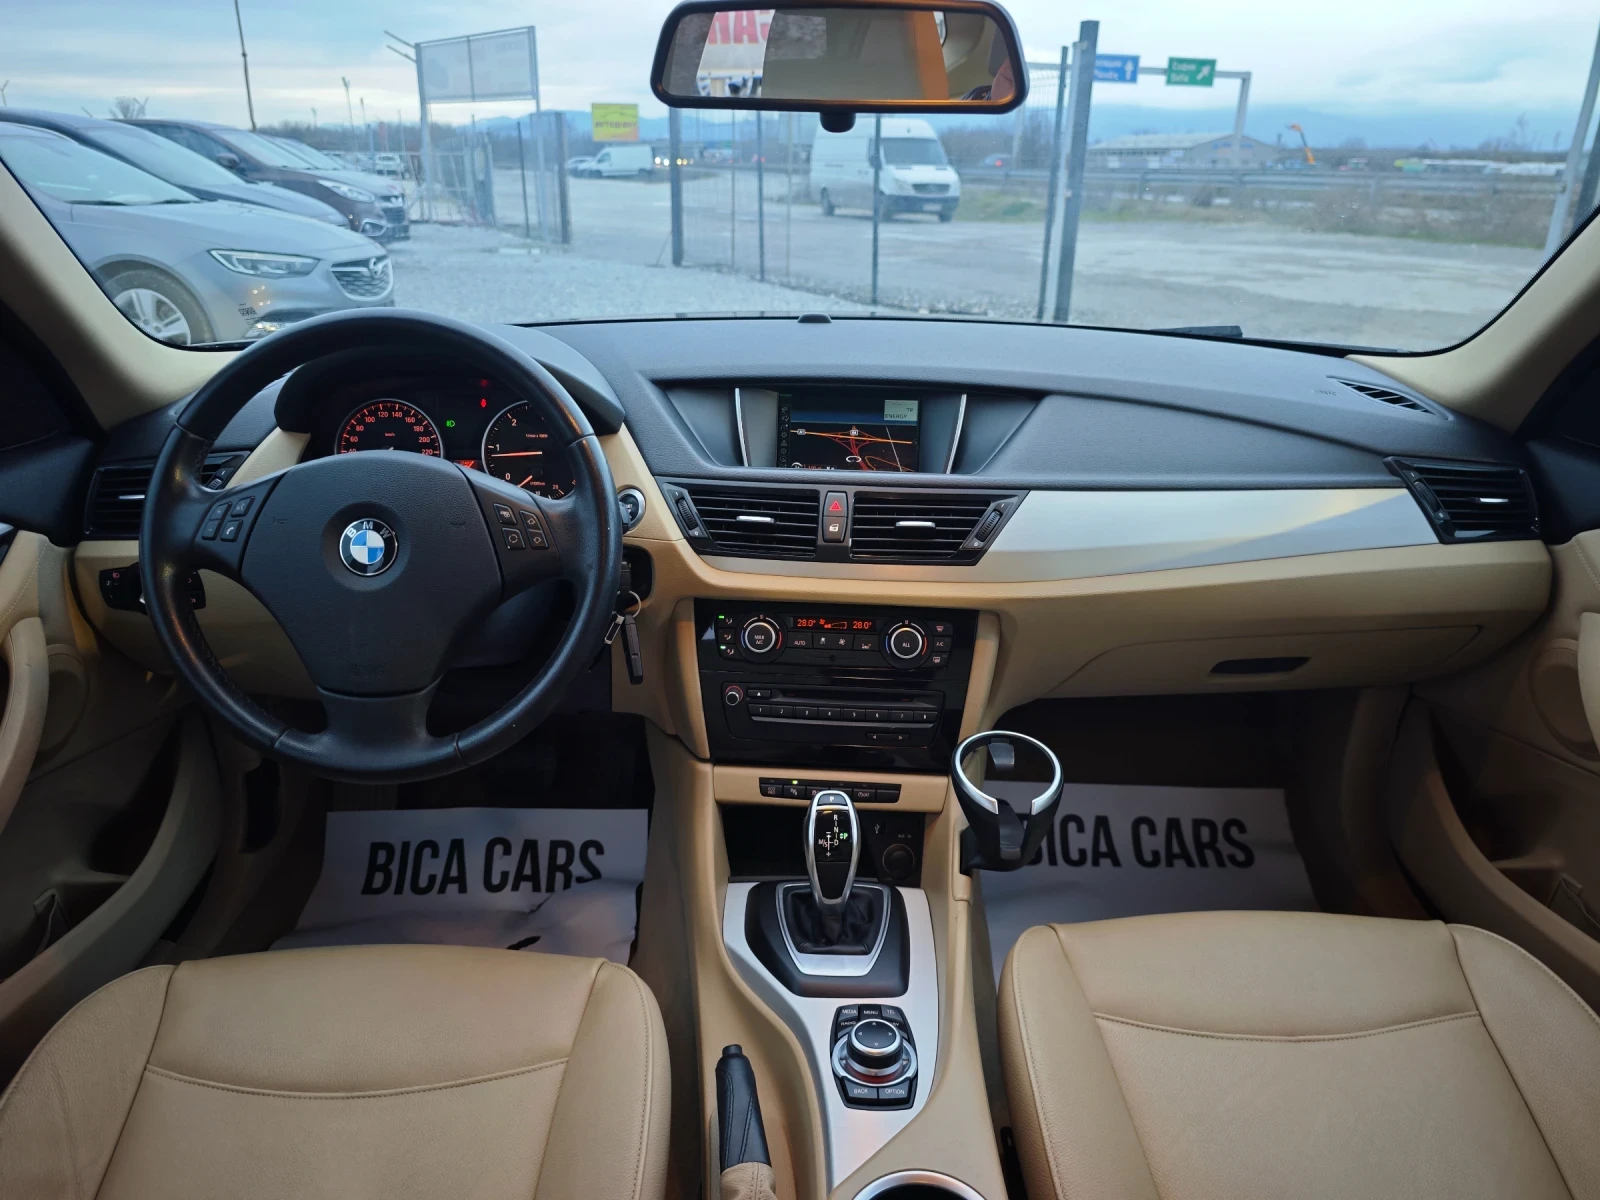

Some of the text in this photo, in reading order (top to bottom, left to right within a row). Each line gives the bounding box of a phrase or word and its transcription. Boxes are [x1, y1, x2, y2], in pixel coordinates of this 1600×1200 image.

[347, 521, 391, 539] BMW
[361, 837, 605, 896] BICA CARS
[1131, 816, 1255, 869] CARS
